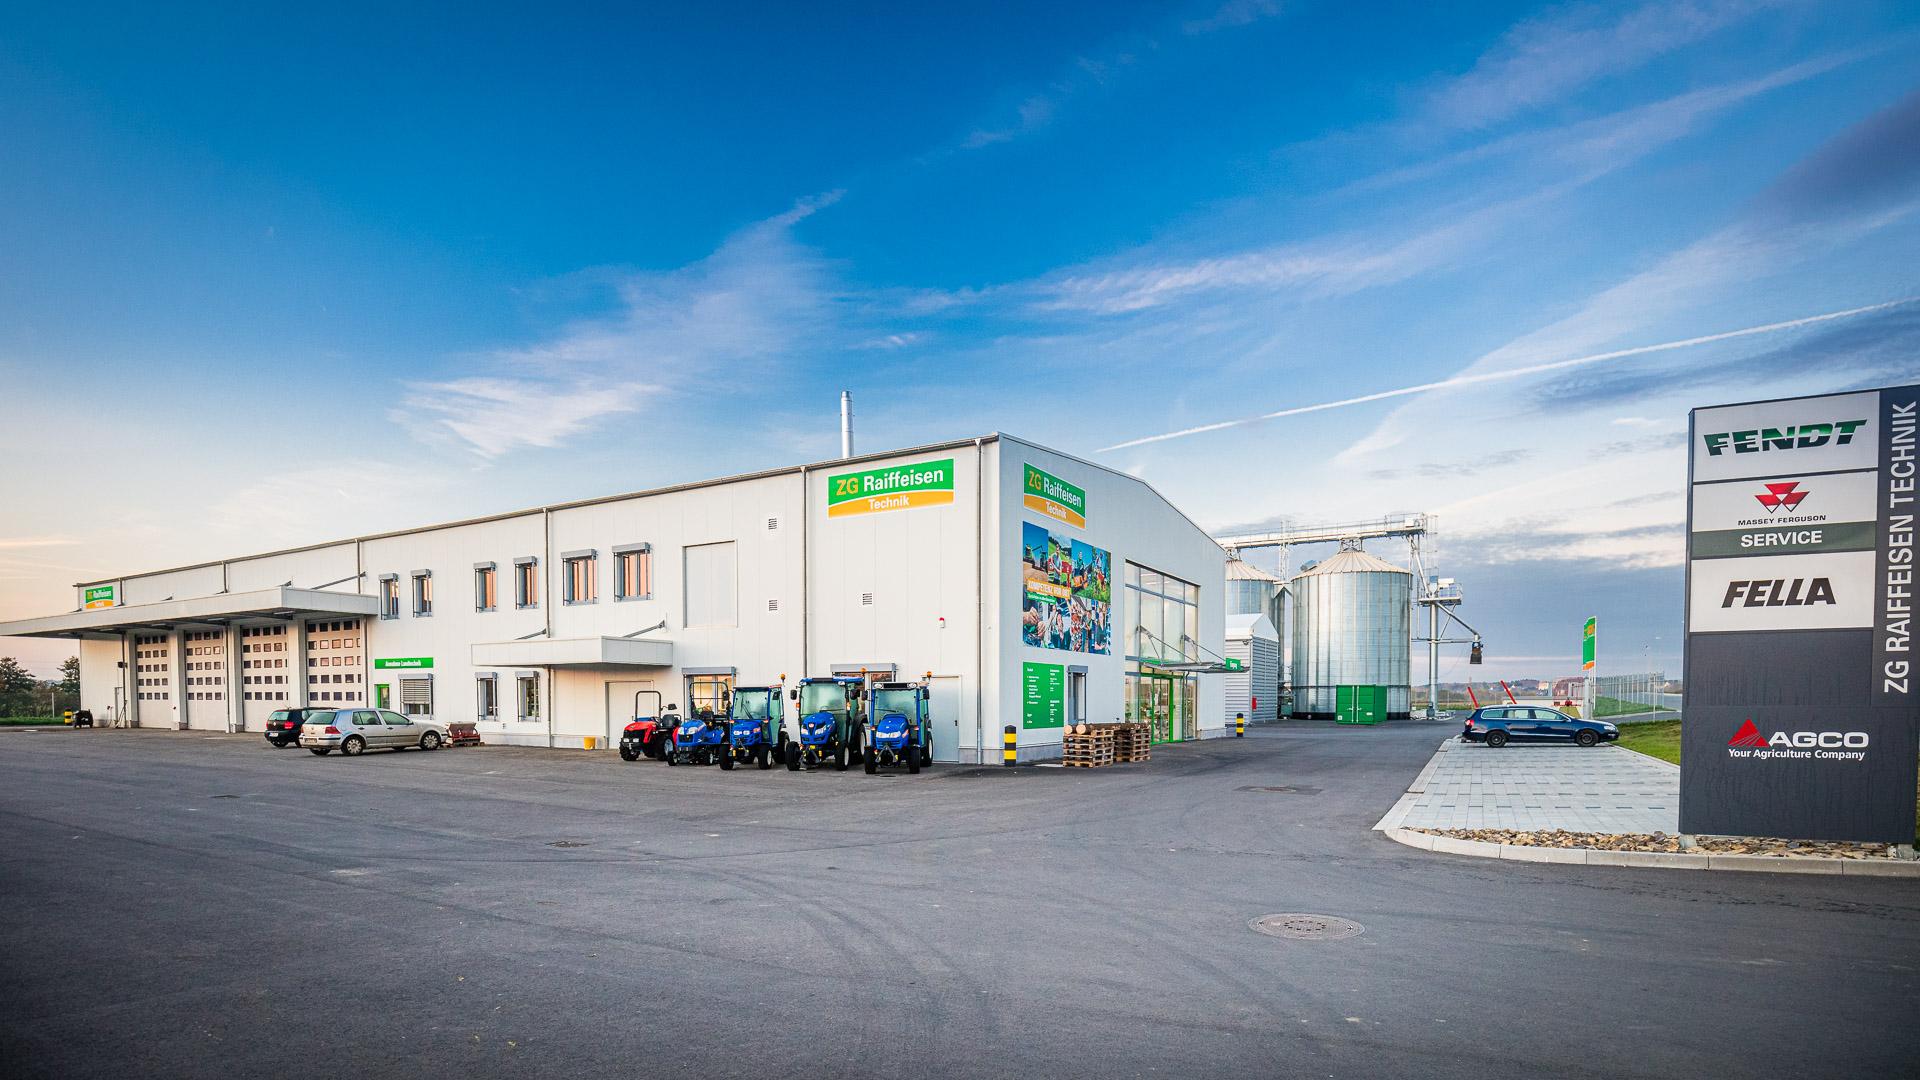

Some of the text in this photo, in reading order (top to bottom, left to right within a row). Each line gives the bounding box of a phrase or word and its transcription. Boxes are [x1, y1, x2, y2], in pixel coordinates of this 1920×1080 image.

[1703, 419, 1868, 457] FENDT
[836, 469, 944, 496] ZG Raiffeisen
[1028, 470, 1082, 508] ZG Raiffeisen
[868, 495, 909, 510] Technik
[1738, 514, 1827, 526] MASSEY FERGUSON
[1740, 530, 1823, 548] SERVICE
[1884, 401, 1917, 693] ZG RAIFFEISEN TECHNIK
[1721, 577, 1837, 609] FELLA
[1768, 731, 1869, 748] AGCO
[1728, 748, 1865, 761] Your Agriculture Company
